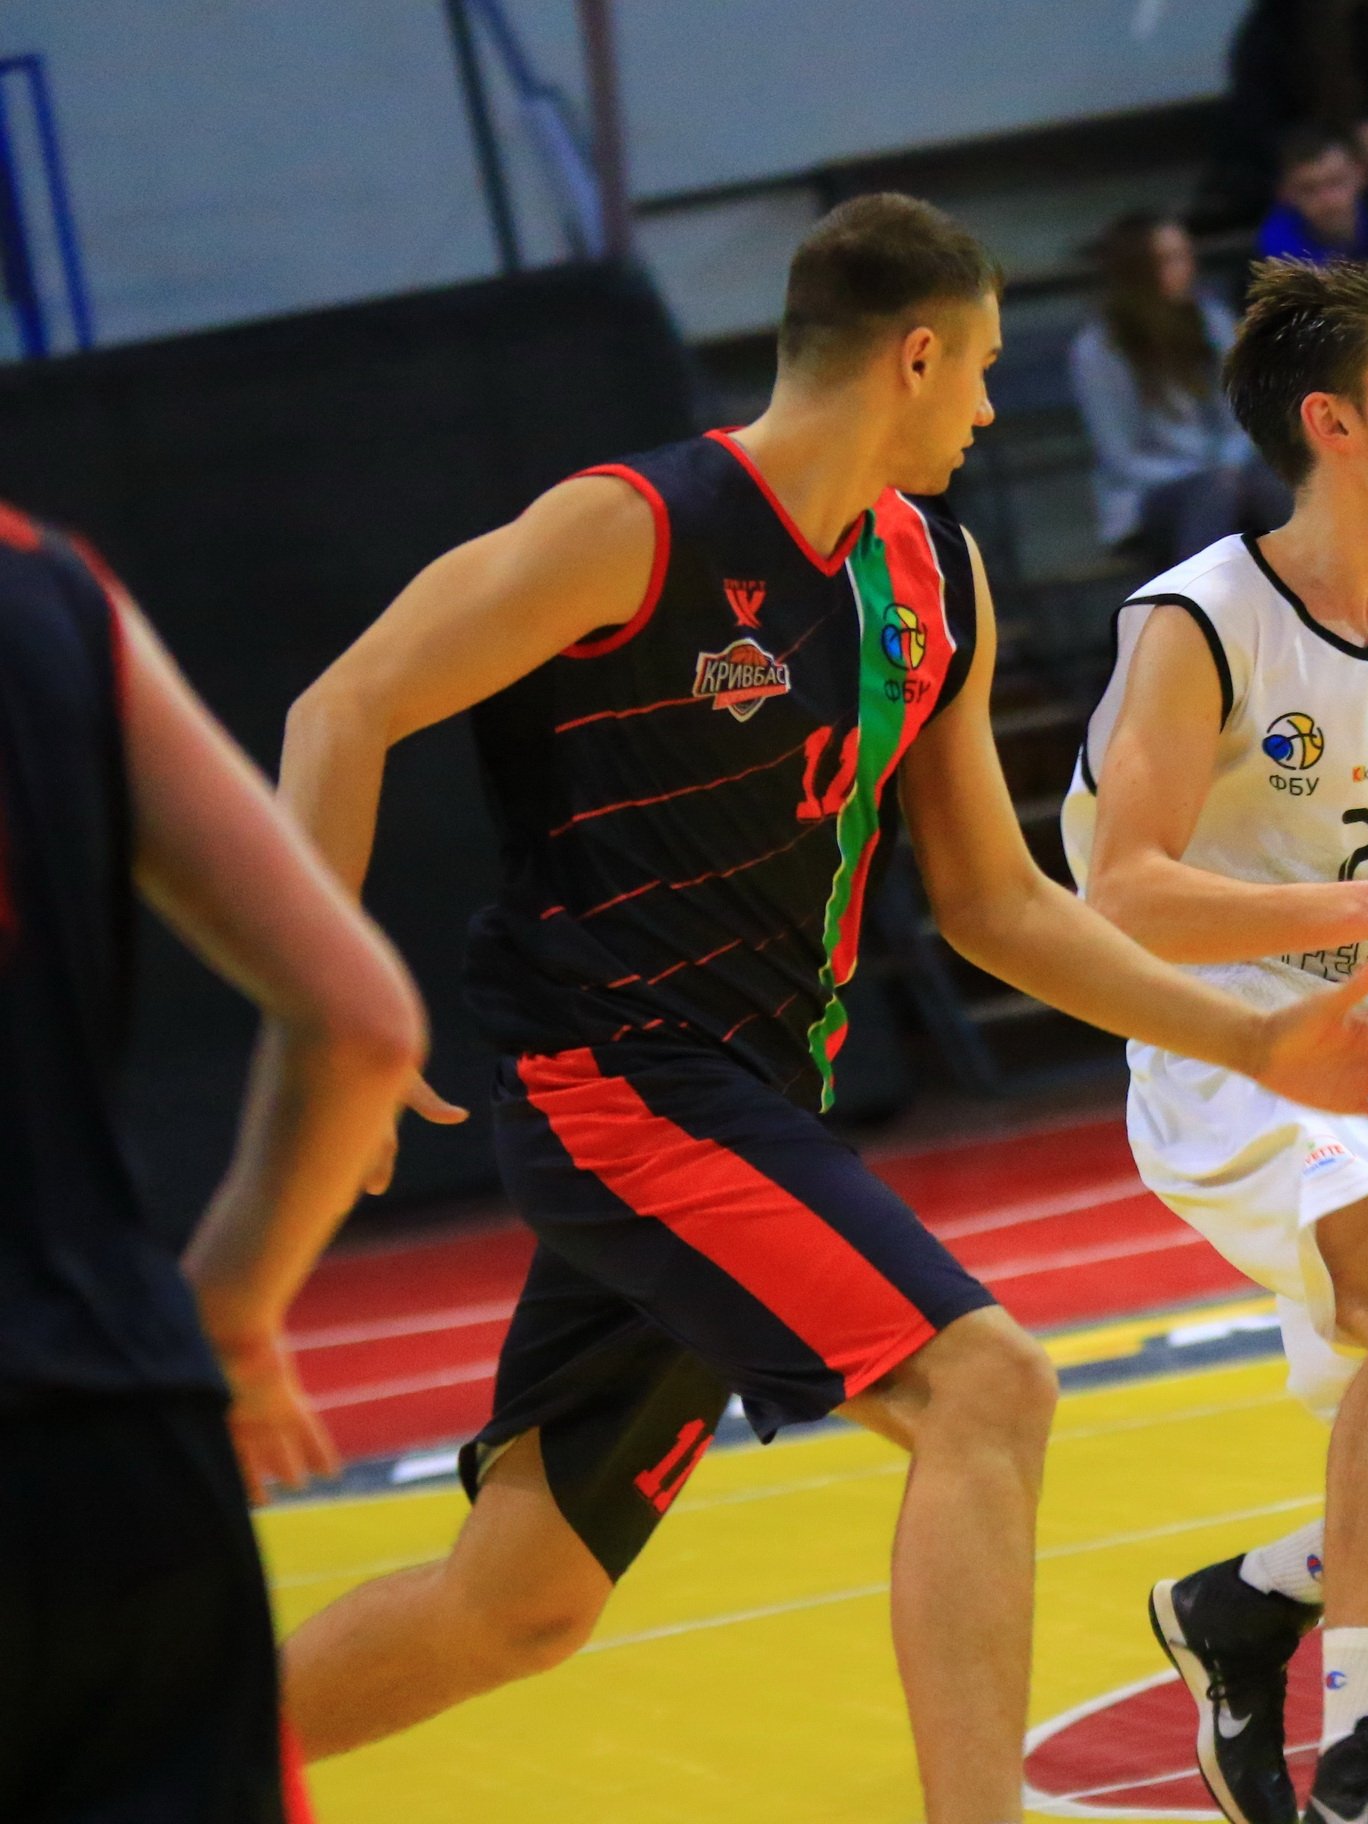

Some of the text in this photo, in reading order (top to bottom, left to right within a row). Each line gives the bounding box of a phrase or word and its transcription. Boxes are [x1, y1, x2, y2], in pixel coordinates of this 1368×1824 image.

[700, 660, 787, 693] КРИВБАС
[884, 678, 931, 704] ФБУ
[1269, 774, 1320, 796] ФБУ
